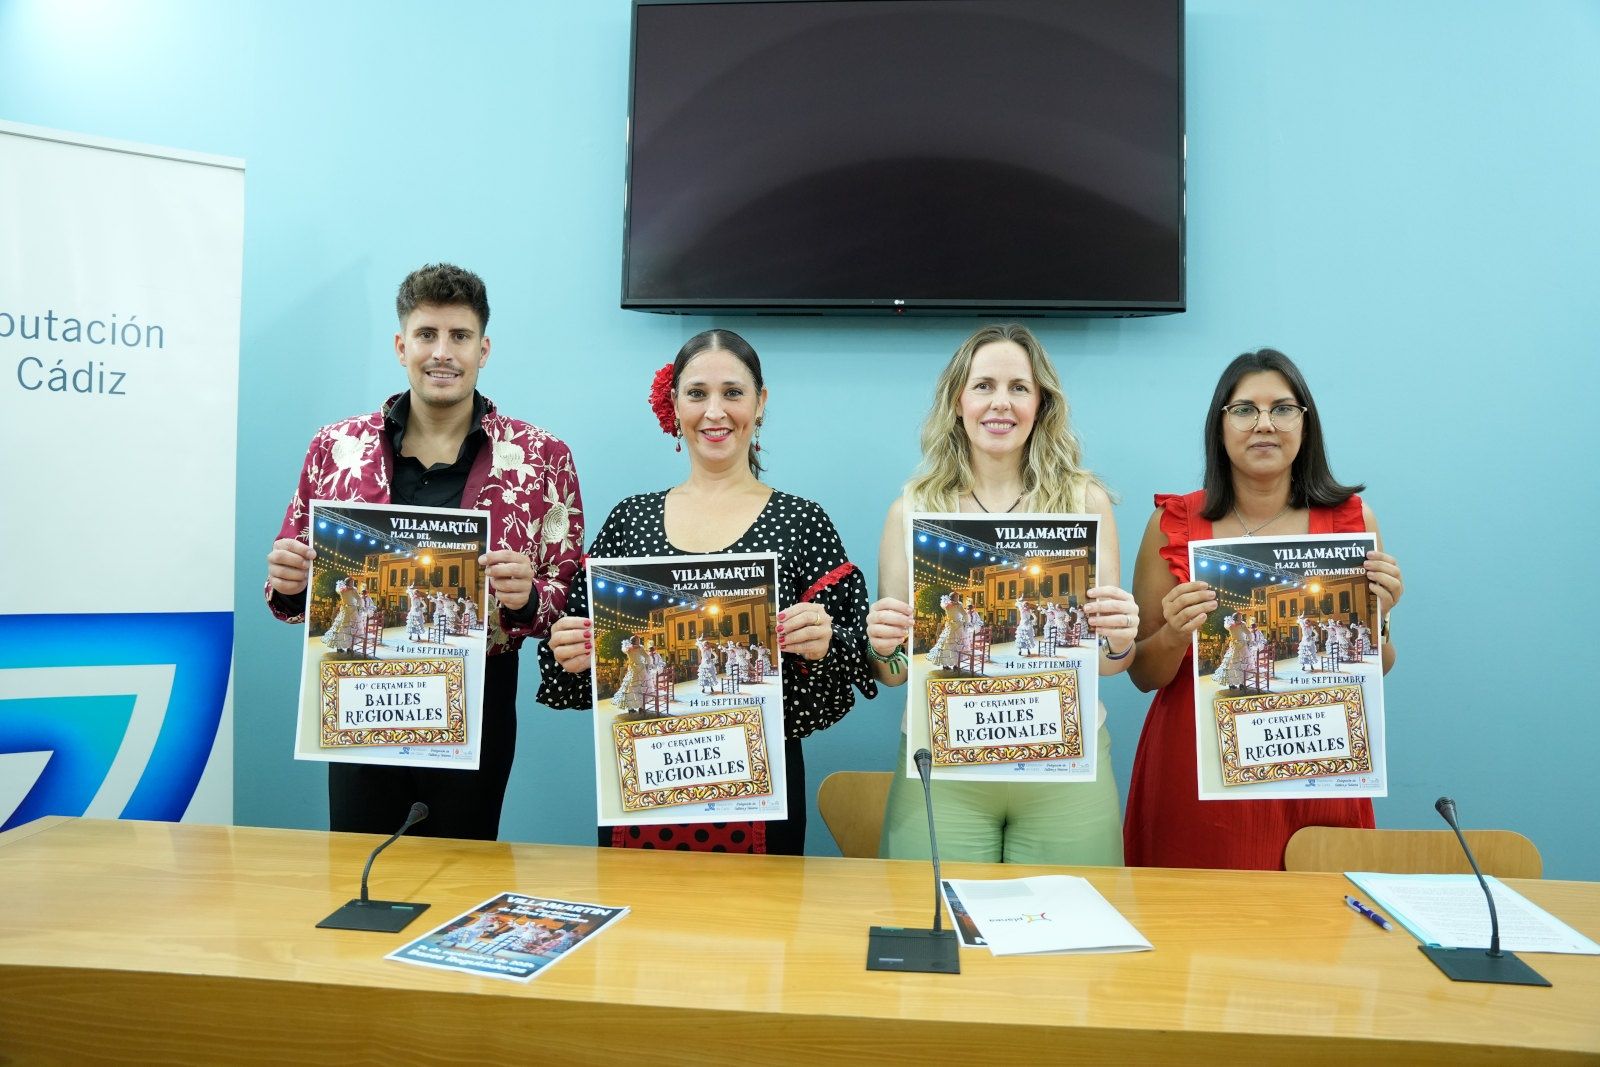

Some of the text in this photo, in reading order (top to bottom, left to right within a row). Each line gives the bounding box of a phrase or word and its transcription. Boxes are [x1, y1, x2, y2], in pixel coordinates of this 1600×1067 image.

[17, 356, 126, 395] Cádiz
[390, 518, 478, 533] VILLAMARTÍN
[995, 523, 1087, 541] VILLAMARTÍN
[390, 531, 431, 541] PLAZA DEL
[418, 540, 477, 550] AYUNTAMIENTO
[996, 541, 1038, 549] PLAZA DEL
[1273, 543, 1365, 561] VILLAMARTÍN
[671, 563, 765, 581] VILLAMARTÍN
[1304, 568, 1366, 576] AYUNTAMIENTO
[702, 588, 765, 598] AYUNTAMIENTO
[396, 645, 405, 653] 14
[417, 646, 469, 657] SEPTIEMBRE
[1005, 661, 1015, 669] 14
[1027, 660, 1082, 669] SEPTIEMBRE
[371, 682, 414, 690] CERTAMEN
[1312, 676, 1366, 684] SEPTIEMBRE
[365, 693, 421, 707] BAILES
[690, 699, 699, 707] 14
[712, 697, 766, 705] SEPTIEMBRE
[980, 698, 1026, 708] CERTAMEN
[345, 709, 443, 725] REGIONALES
[976, 710, 1033, 725] BAILES
[1268, 713, 1312, 725] CERTAMEN
[956, 723, 1057, 743] REGIONALES
[1264, 724, 1320, 742] BAILES
[667, 736, 712, 748] CERTAMEN
[715, 734, 725, 742] DE
[663, 747, 721, 765] BAILES
[1246, 737, 1344, 761] REGIONALES
[645, 760, 745, 786] REGIONALES
